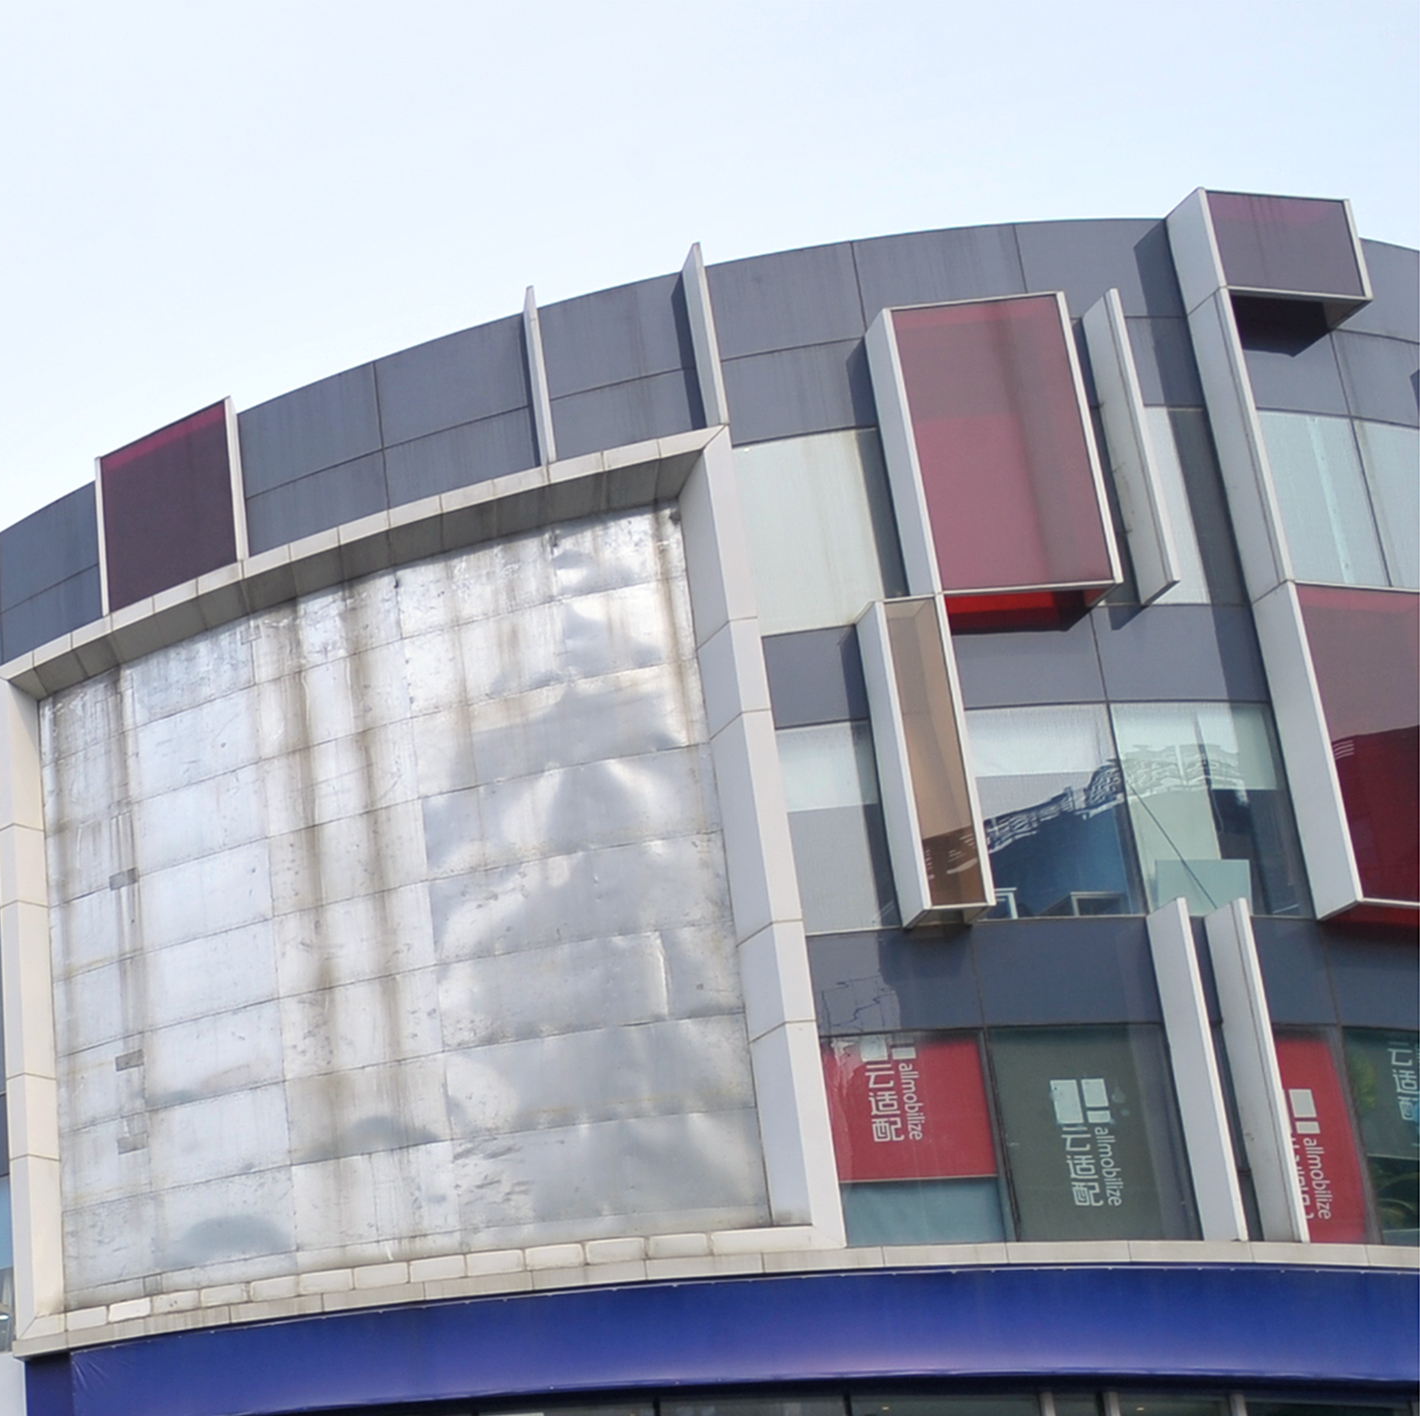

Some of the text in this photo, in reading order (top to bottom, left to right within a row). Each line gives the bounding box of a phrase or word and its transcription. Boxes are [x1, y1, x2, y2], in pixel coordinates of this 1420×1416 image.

[865, 1063, 905, 1142] 云适配
[898, 1062, 926, 1140] allmobilize
[1061, 1126, 1104, 1206] 云适配
[1094, 1126, 1124, 1206] allmobilize
[1303, 1137, 1333, 1220] allmobilize
